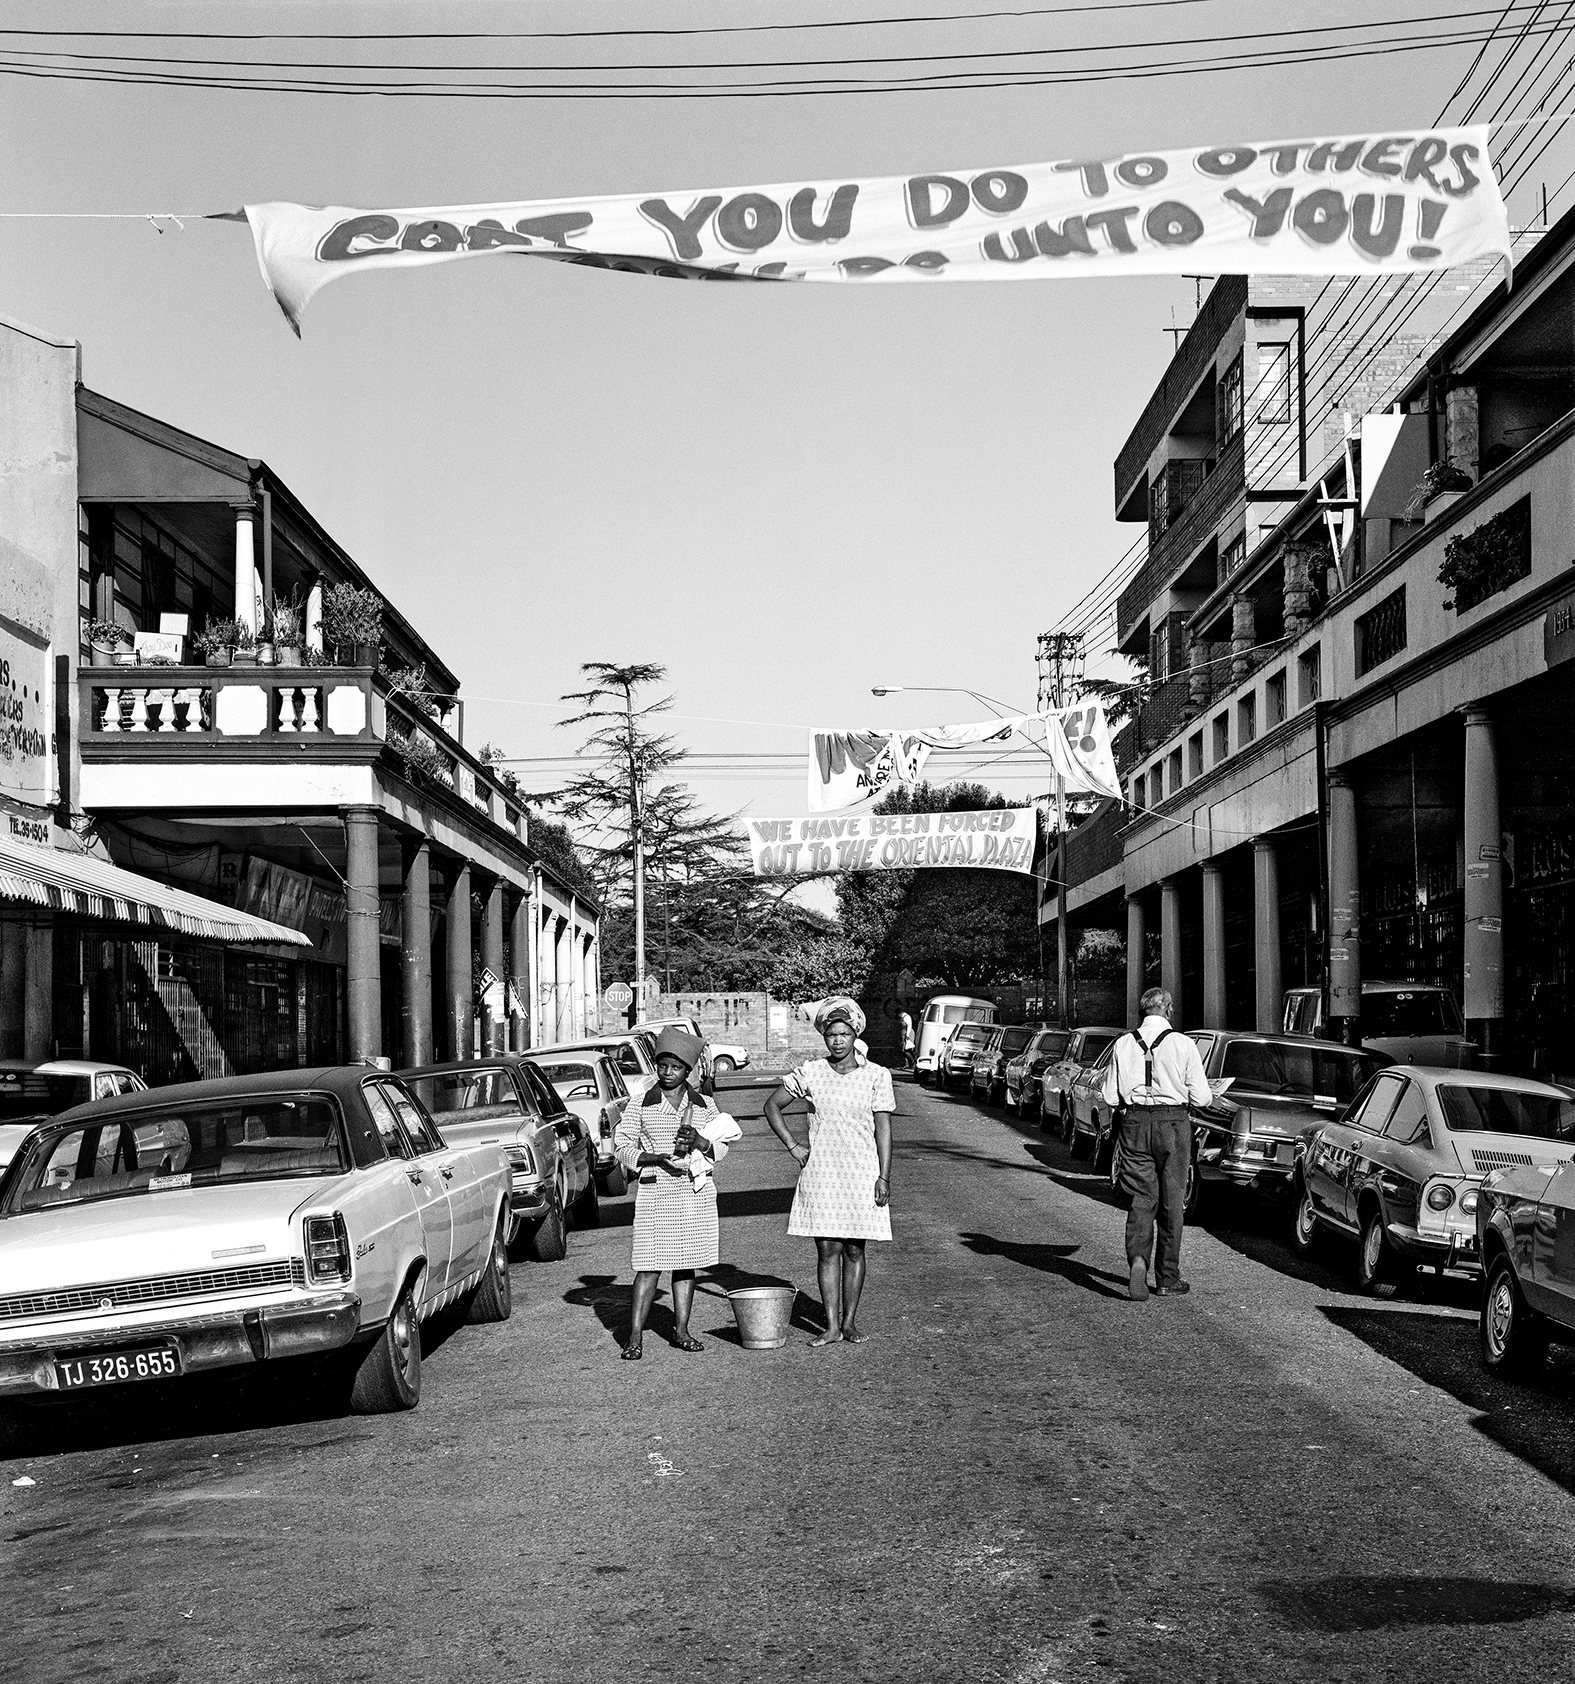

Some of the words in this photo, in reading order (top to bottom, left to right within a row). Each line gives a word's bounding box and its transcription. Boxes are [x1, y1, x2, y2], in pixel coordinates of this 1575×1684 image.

[638, 184, 859, 260] YOU
[904, 170, 1028, 231] DO
[1051, 157, 1168, 198] TO
[1193, 136, 1481, 198] OTHERS
[979, 201, 1205, 262] UNTO
[1220, 187, 1450, 264] YOU!
[752, 820, 793, 843] WE
[800, 818, 861, 841] HAVE
[869, 814, 931, 836] BEEN
[938, 811, 1016, 833] FORCED
[758, 842, 803, 876] OUT
[836, 838, 878, 871] THE
[880, 835, 977, 868] ORIENTAL
[978, 834, 1034, 870] PLAZA
[608, 990, 630, 1002] STOP
[60, 1361, 84, 1386] TJ
[89, 1350, 175, 1382] 326-655
